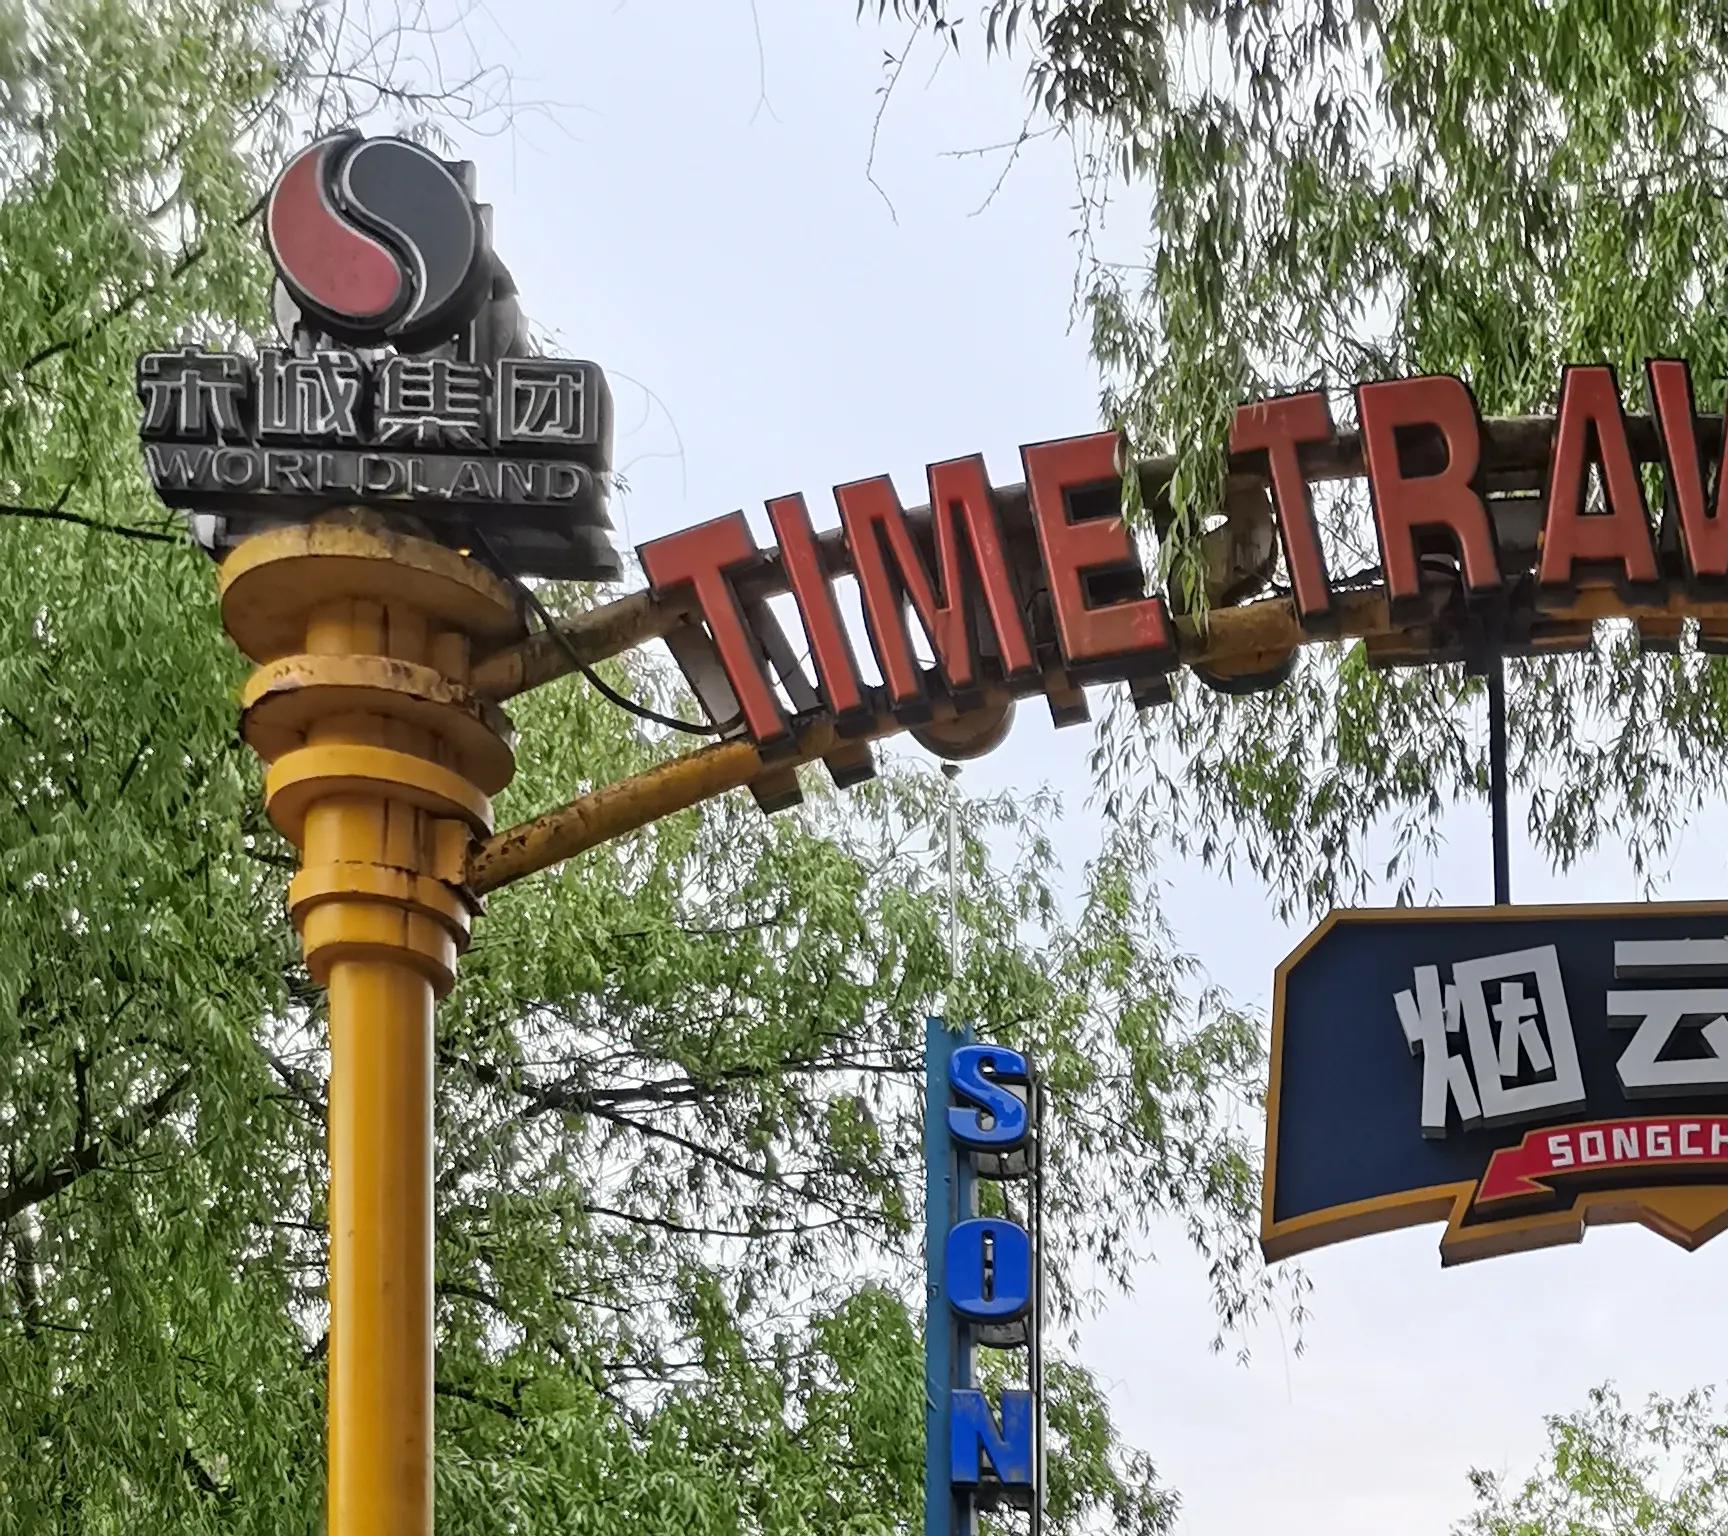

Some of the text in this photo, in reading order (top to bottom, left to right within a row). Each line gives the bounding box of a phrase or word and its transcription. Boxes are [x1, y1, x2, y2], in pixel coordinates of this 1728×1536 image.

[141, 345, 592, 444] 宋城集团
[145, 446, 590, 502] WORLDLAND
[636, 431, 1173, 743] TIME
